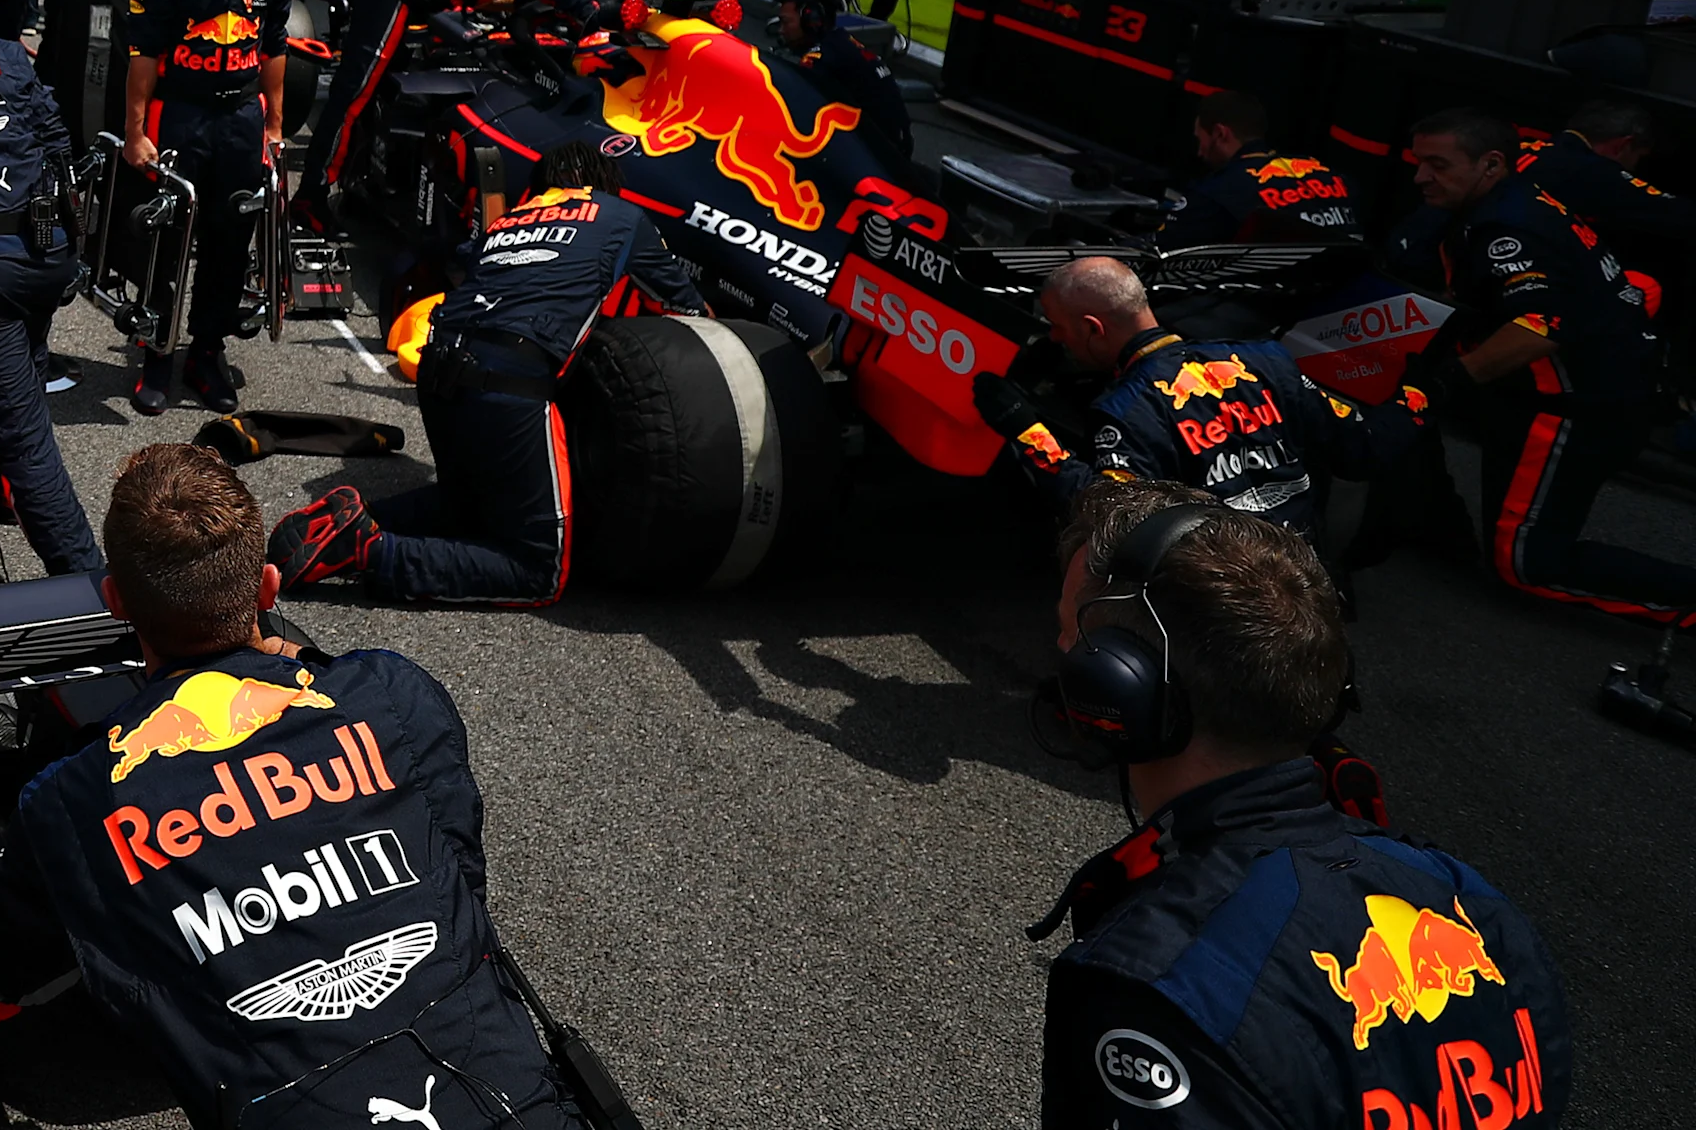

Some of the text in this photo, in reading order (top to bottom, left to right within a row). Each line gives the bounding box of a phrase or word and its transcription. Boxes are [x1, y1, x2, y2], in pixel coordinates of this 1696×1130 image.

[1105, 2, 1148, 43] 23
[173, 44, 259, 72] Red Bull
[1257, 175, 1349, 210] Red Bull
[486, 202, 600, 234] Red Bull
[482, 226, 546, 253] Mobil
[894, 236, 952, 286] AT&T
[1160, 258, 1222, 270] MARTIN
[717, 277, 755, 308] SIEMENS
[768, 265, 827, 300] HYBR
[850, 273, 976, 376] ESSO
[1317, 297, 1430, 343] simply COLA
[1336, 361, 1383, 382] Red Bull
[103, 720, 396, 886] Red Bull
[171, 842, 358, 965] Mobil
[297, 950, 386, 997] ASTON MARTIN
[1447, 1007, 1544, 1130] Bull
